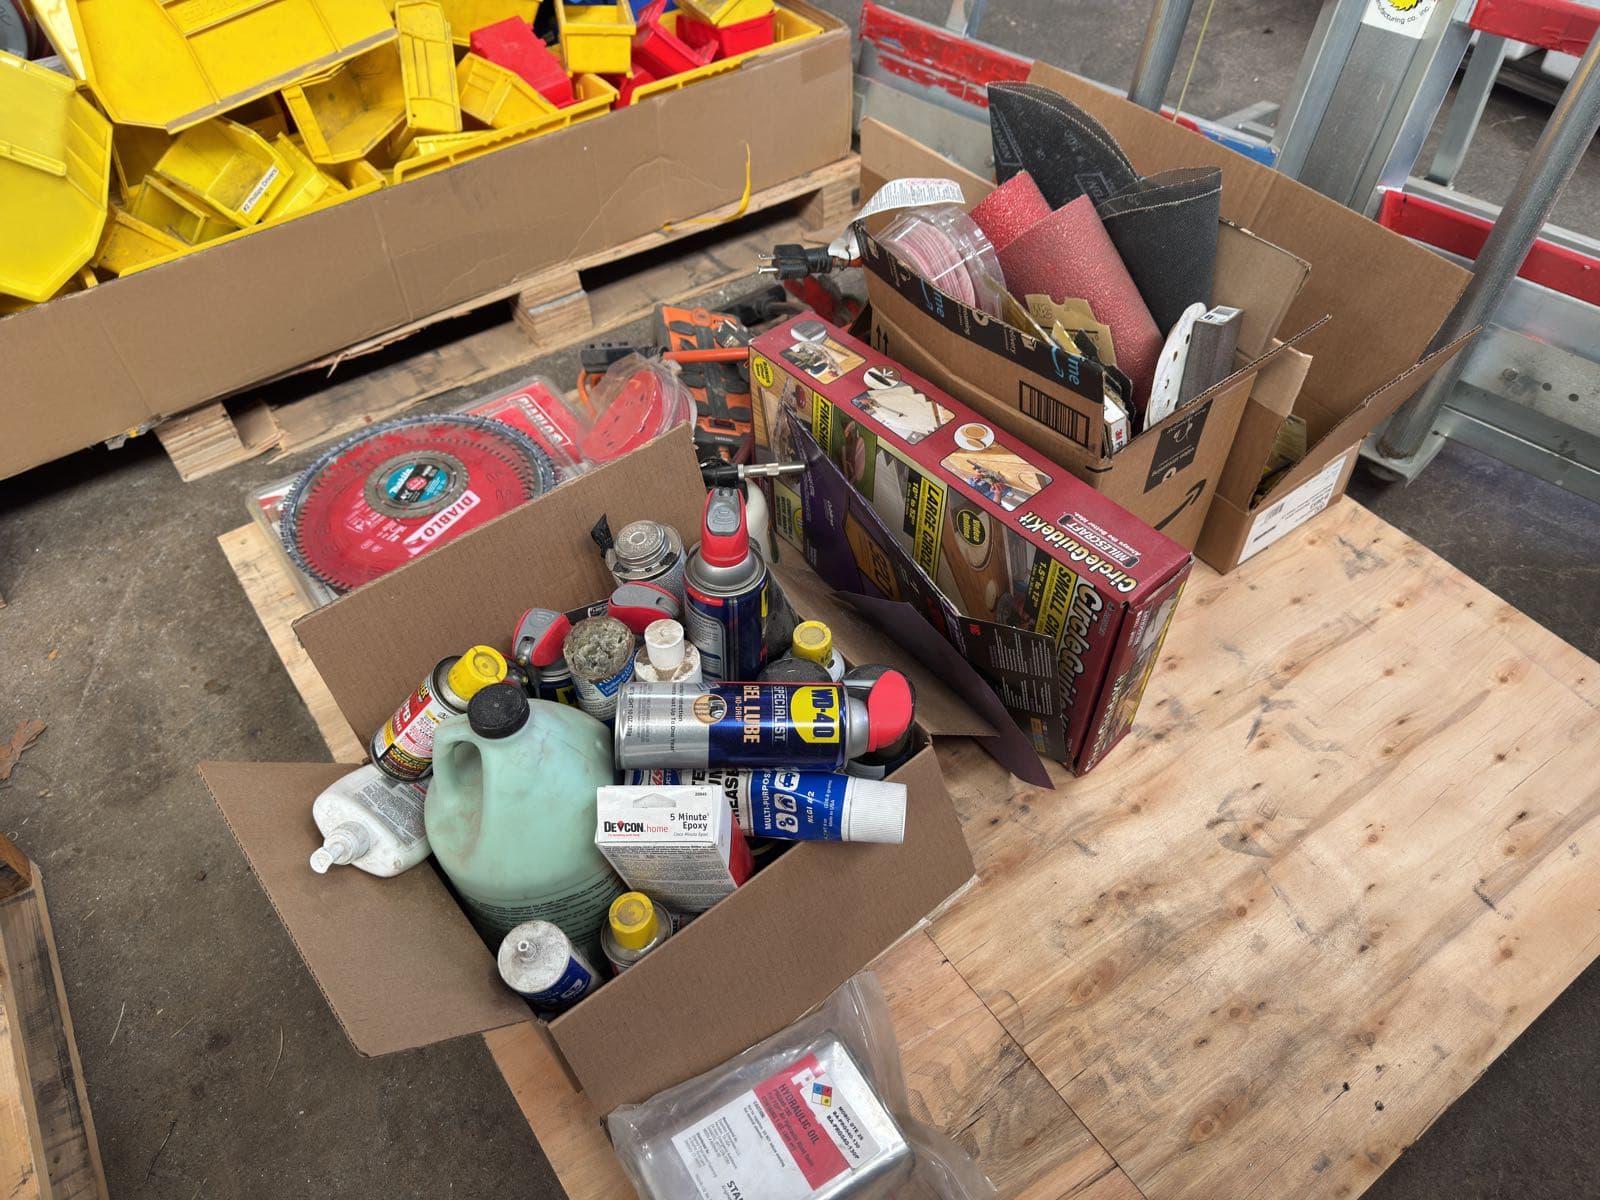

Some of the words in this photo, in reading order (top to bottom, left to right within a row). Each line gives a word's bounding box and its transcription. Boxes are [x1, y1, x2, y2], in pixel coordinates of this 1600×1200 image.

[423, 495, 474, 538] DIABLO
[926, 484, 942, 529] LARGE
[1087, 520, 1108, 536] Better
[922, 530, 938, 578] CIRCL
[1017, 511, 1138, 593] CircleGuideKit
[1065, 519, 1130, 564] MILESCRAFT
[1118, 540, 1142, 557] Always
[1049, 567, 1073, 612] SMALL
[735, 695, 743, 722] NO-DRIP
[743, 685, 761, 703] GEL
[773, 684, 787, 740] SPECIALIST
[811, 688, 835, 740] WD-40
[743, 705, 761, 744] LUBE
[682, 821, 708, 831] Epoxy
[806, 806, 815, 826] NLGI
[778, 1083, 812, 1130] HYDRAULIC
[806, 1128, 821, 1145] OIL
[837, 1105, 852, 1124] MOBIL
[849, 1121, 859, 1134] DTE
